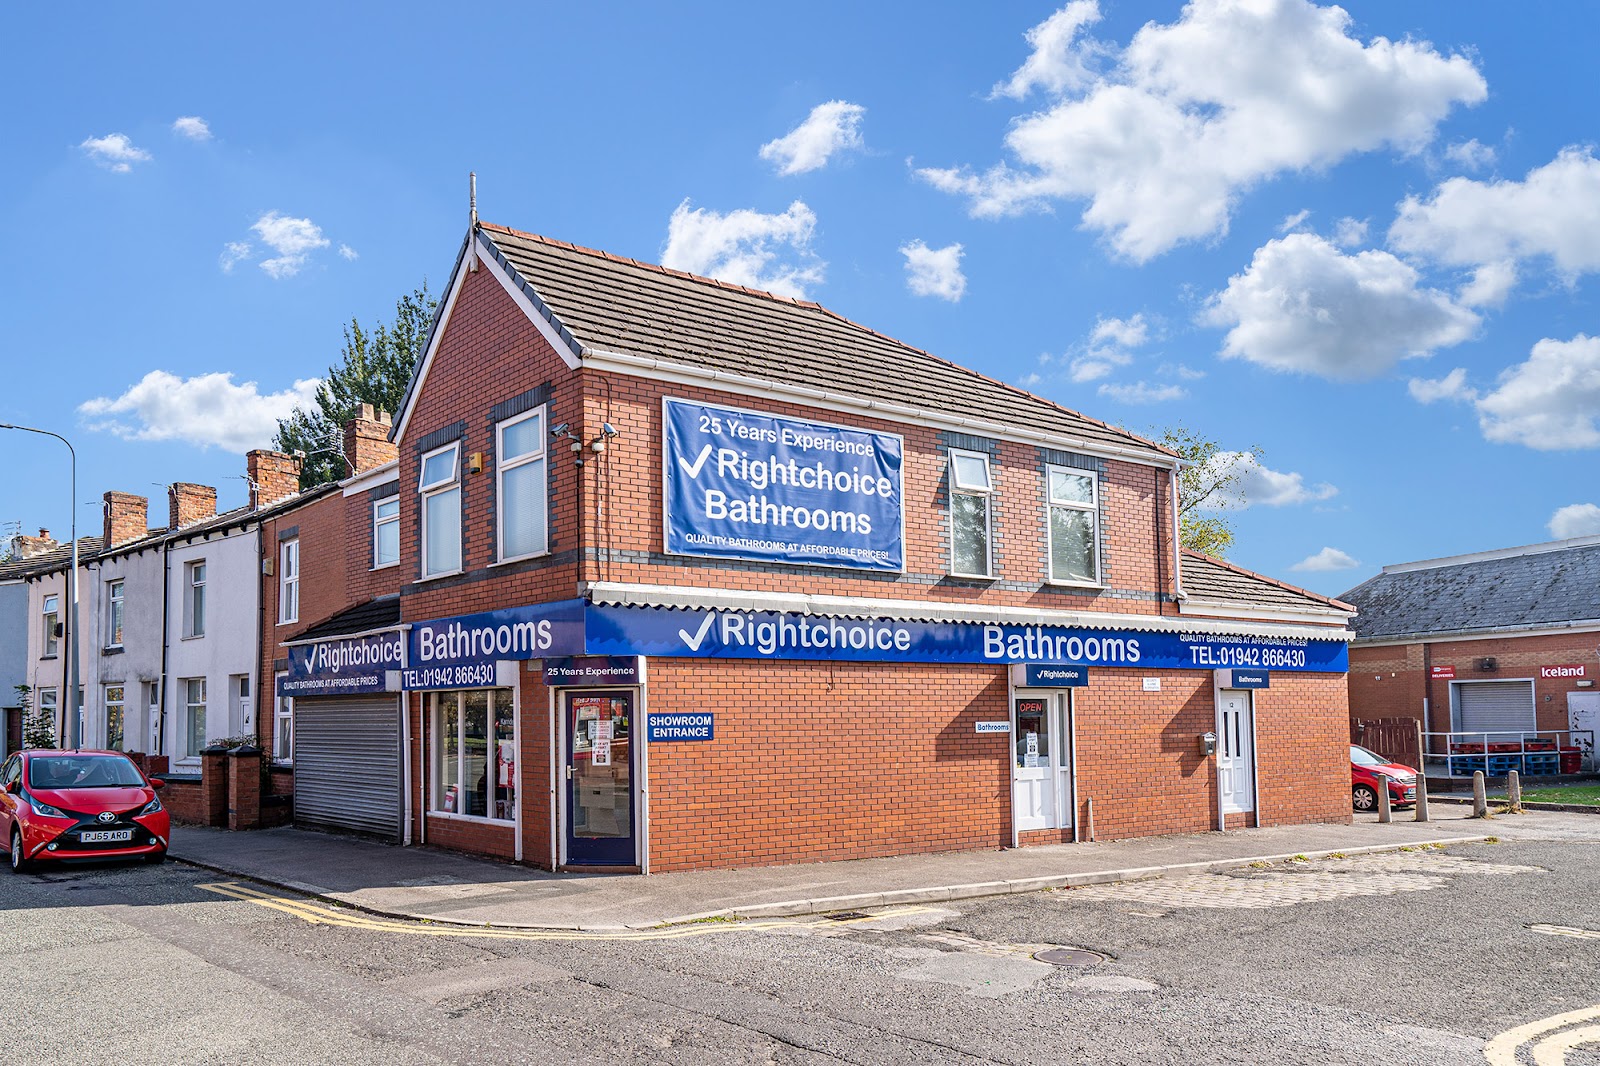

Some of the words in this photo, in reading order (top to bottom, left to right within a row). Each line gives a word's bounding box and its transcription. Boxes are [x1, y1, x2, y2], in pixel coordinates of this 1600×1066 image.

[699, 415, 722, 435] 25
[726, 419, 777, 443] Years
[782, 428, 875, 457] Experience
[717, 448, 892, 498] Rightchoice
[705, 489, 872, 534] Bathrooms
[685, 533, 727, 547] QUALITY
[728, 537, 786, 551] BATHROOMS
[787, 541, 799, 552] AT
[800, 542, 857, 557] AFFORDABLE
[857, 548, 889, 560] PRICES!
[420, 619, 552, 662] Bathrooms
[722, 612, 911, 654] Rightchoice
[1179, 633, 1206, 643] QUALITY
[1206, 634, 1243, 644] BATHROOMS
[1243, 636, 1251, 644] AT
[1251, 637, 1287, 646] AFFORDABLE
[983, 625, 1141, 663] Bathrooms
[318, 636, 401, 674] Rightchoice
[1189, 645, 1260, 666] TEL:01942
[1262, 648, 1306, 667] 866430
[403, 667, 453, 688] TEL:01942
[454, 664, 493, 686] 866430
[547, 667, 559, 676] 25
[560, 667, 584, 676] Years
[585, 667, 635, 677] Experience
[1043, 670, 1079, 679] Rightchoice
[1541, 666, 1584, 678] Iceland
[283, 681, 300, 690] QUALITY
[300, 679, 325, 689] BATHROOMS
[324, 679, 331, 687] AT
[330, 677, 360, 687] AFFORDABLE
[1020, 703, 1043, 712] OPEN
[650, 716, 712, 726] SHOWROOM
[977, 723, 1009, 731] Bathrooms
[653, 727, 709, 738] ENTRANCE
[84, 832, 109, 841] PJ65
